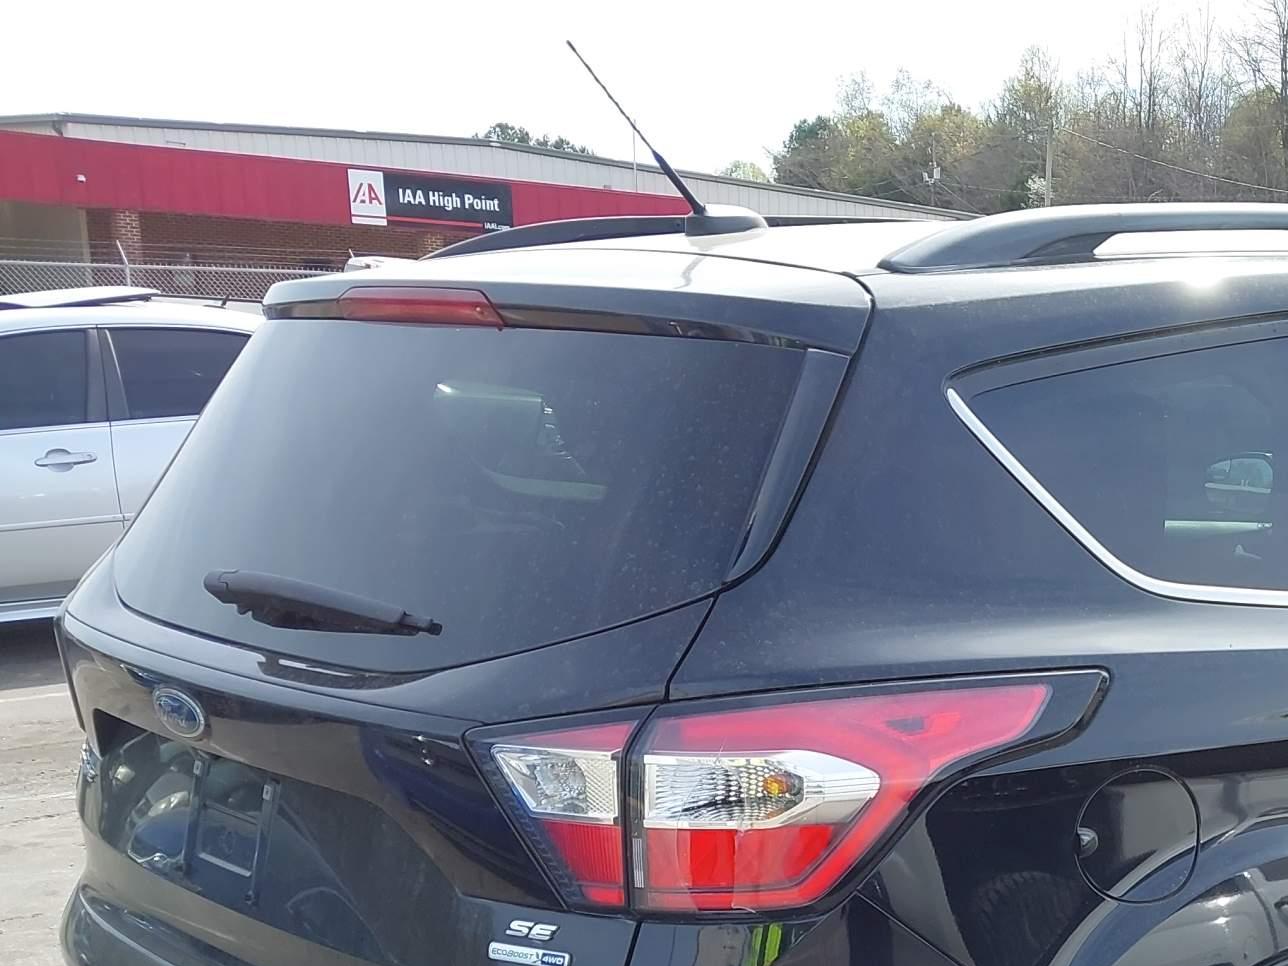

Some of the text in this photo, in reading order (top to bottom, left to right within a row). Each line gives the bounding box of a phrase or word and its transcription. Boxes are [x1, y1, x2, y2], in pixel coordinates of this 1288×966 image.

[398, 188, 500, 212] IAA High Point
[505, 920, 559, 940] SE
[541, 954, 564, 966] 4WD
